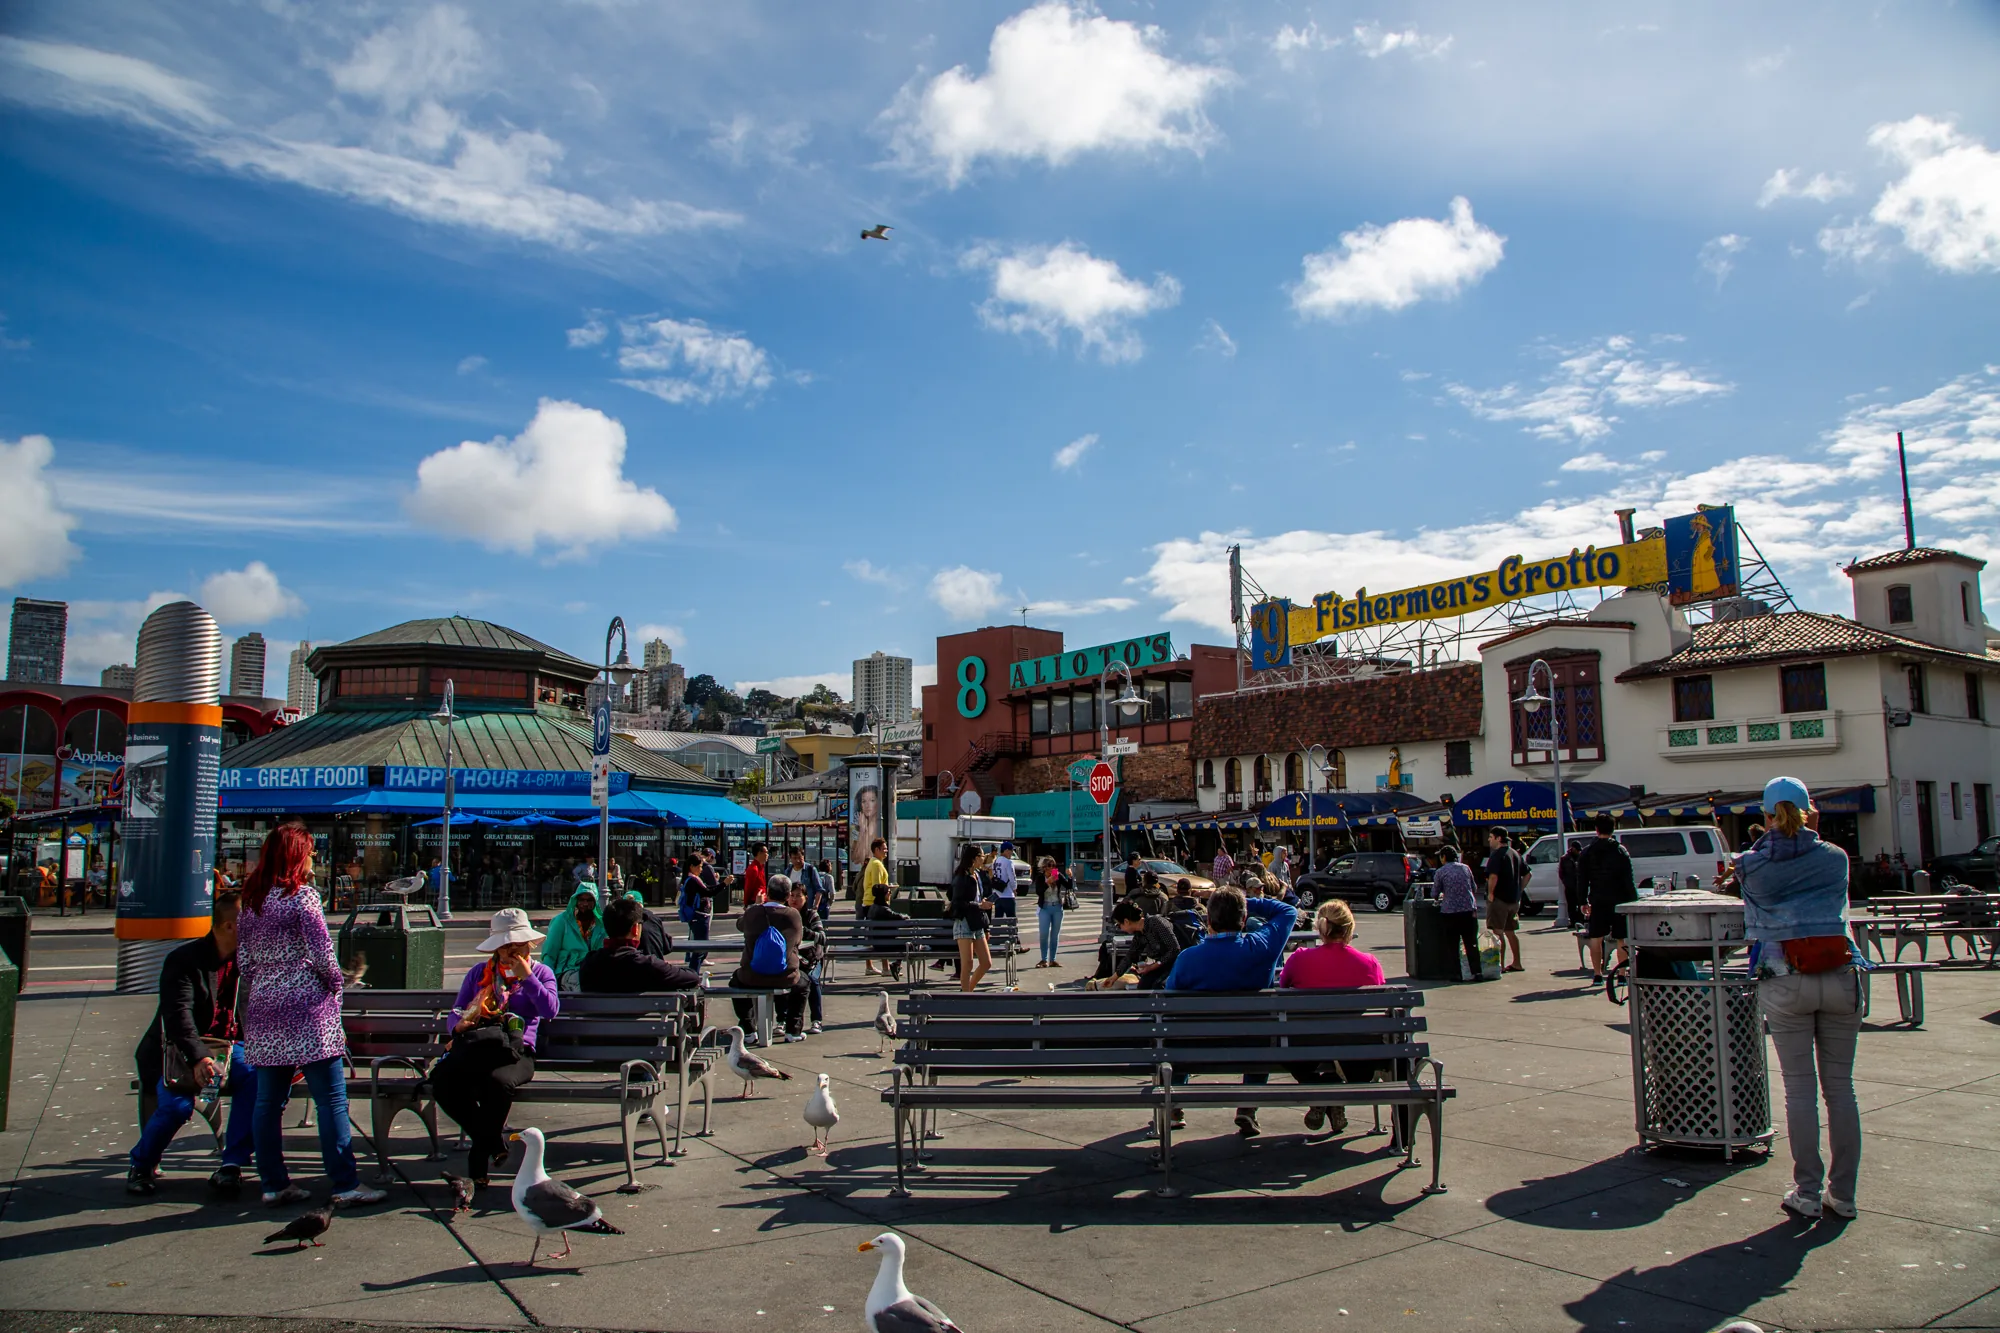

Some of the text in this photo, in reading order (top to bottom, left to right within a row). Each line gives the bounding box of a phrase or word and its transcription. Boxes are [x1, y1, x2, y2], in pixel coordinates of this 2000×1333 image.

[1314, 544, 1620, 632] Fishermen's Grotto
[1011, 635, 1168, 689] ALIOTO'S
[957, 655, 986, 719] 8
[273, 706, 308, 724] Appl
[879, 725, 922, 743] Tarant
[219, 768, 241, 788] AR
[257, 767, 310, 788] GREAT
[314, 766, 365, 787] FOOD!
[463, 770, 519, 788] HOUR
[522, 773, 566, 787] 4-6PM
[573, 772, 624, 784] WEEAYS
[1091, 775, 1113, 792] STOP
[1275, 816, 1315, 827] Fishermens
[1315, 814, 1338, 826] Grotto
[1474, 808, 1528, 821] Fishermen's
